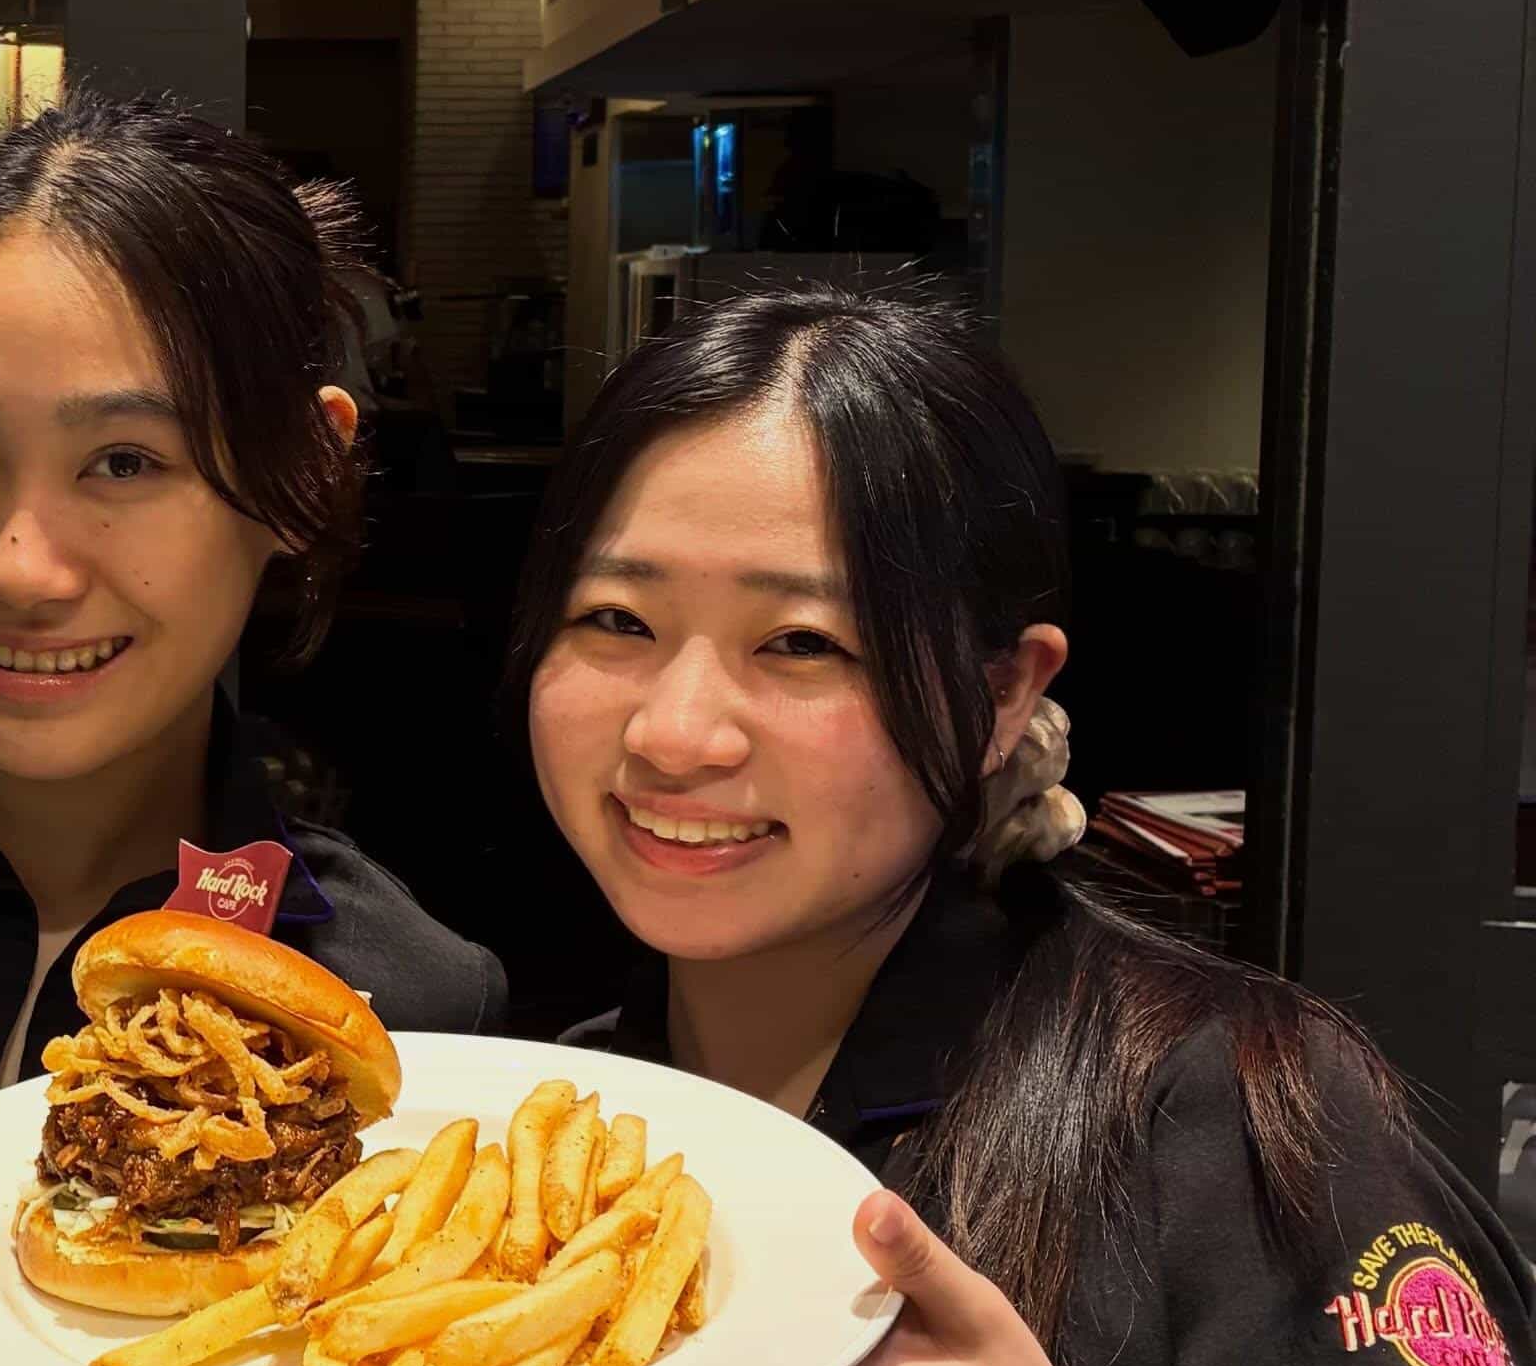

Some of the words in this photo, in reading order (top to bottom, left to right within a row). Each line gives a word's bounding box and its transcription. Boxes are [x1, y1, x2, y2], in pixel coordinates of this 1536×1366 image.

[195, 866, 234, 896] Hard
[229, 873, 269, 908] Rock
[1352, 1235, 1396, 1290] SAVE
[1388, 1221, 1430, 1248] THE
[1324, 1285, 1453, 1353] Hard
